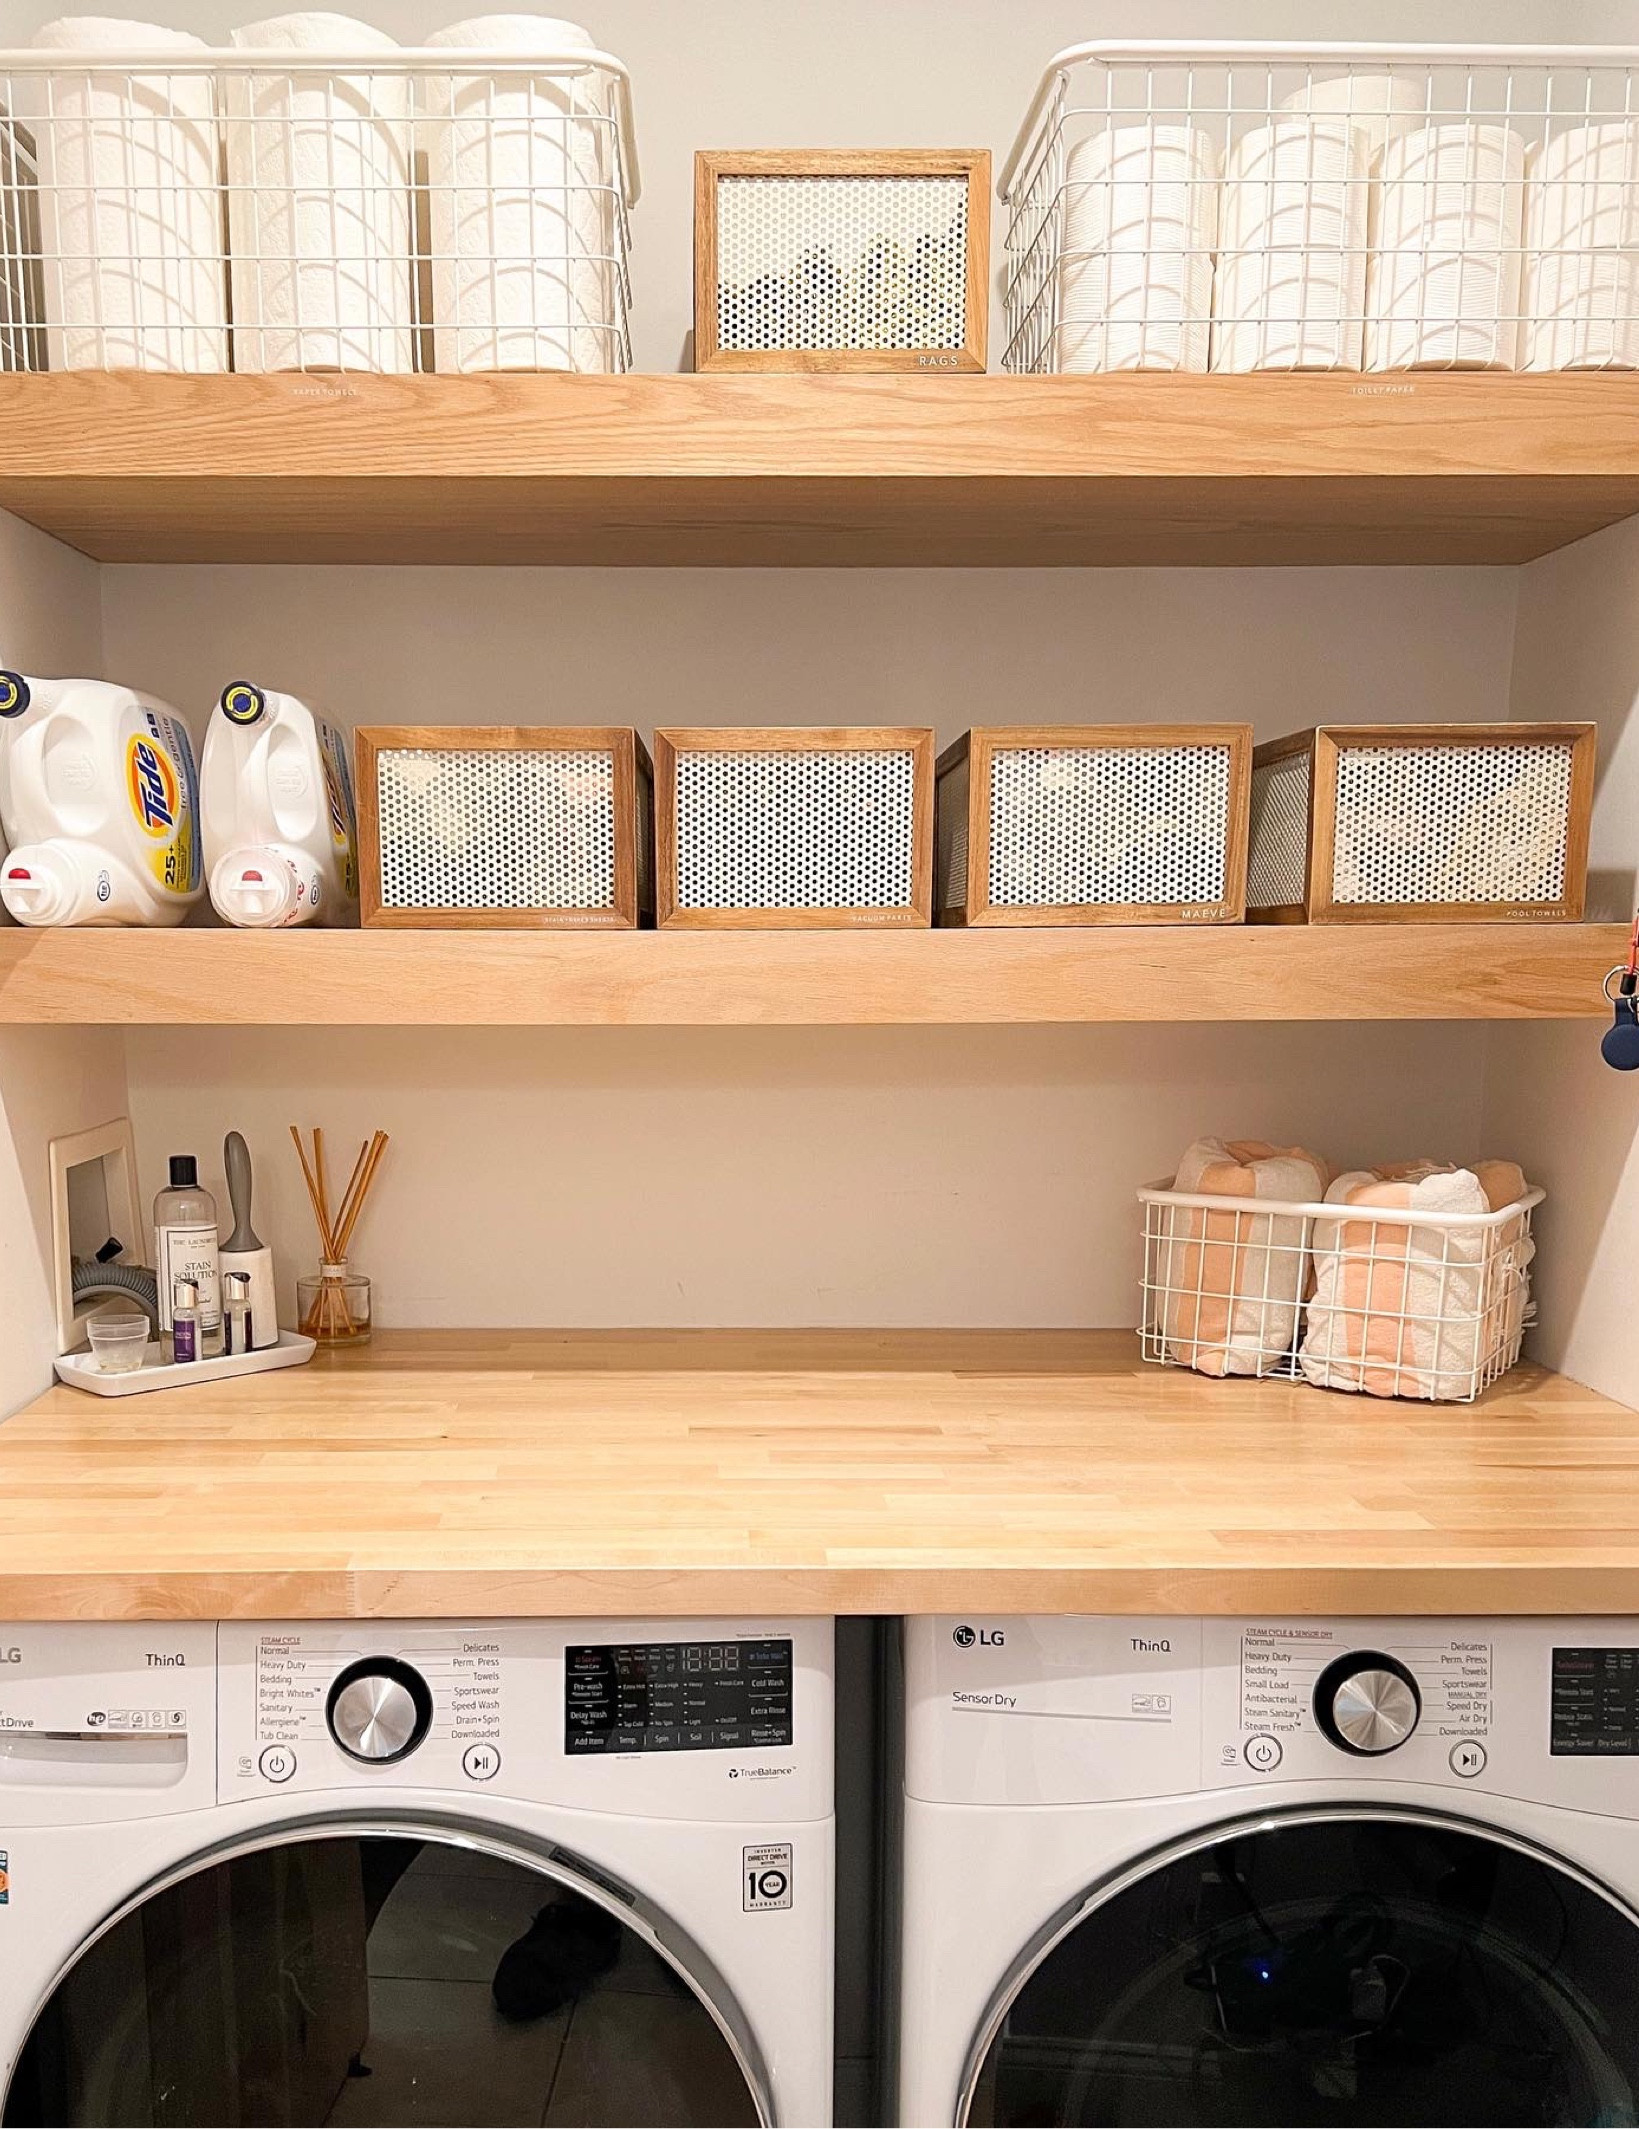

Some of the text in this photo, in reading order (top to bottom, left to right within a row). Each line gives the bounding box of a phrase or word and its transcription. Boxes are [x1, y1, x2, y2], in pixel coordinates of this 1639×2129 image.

[919, 355, 958, 366] RAGS
[137, 741, 174, 827] Tide
[165, 844, 176, 885] 25+
[1182, 909, 1226, 918] MAEVE
[185, 1261, 212, 1271] STAIN
[980, 1630, 1005, 1646] LG
[1245, 1638, 1275, 1647] Normal
[463, 1643, 500, 1653] Delicates
[1131, 1638, 1171, 1652] ThinQ
[1451, 1642, 1488, 1651] Delicates
[260, 1646, 290, 1655] Normal
[145, 1654, 186, 1667] ThinQ
[1245, 1652, 1292, 1662] Heavy Duty
[1466, 1655, 1488, 1664] Press
[260, 1660, 307, 1671] Heavy Duty
[452, 1658, 500, 1667] Perm. Press
[473, 1671, 500, 1680] Towels
[1245, 1666, 1278, 1677] Bedding
[1461, 1667, 1488, 1675] Towels
[260, 1674, 292, 1685] Bedding
[1245, 1680, 1290, 1689] Small Load
[1442, 1680, 1488, 1689] Sportswear
[260, 1689, 285, 1700] Bright
[454, 1686, 500, 1697] Sportswear
[1245, 1694, 1297, 1704] Antibacterial
[260, 1703, 293, 1713] Sanitary
[451, 1700, 500, 1711] Speed Wash
[1446, 1701, 1487, 1711] Speed Dry
[570, 1711, 589, 1720] Delay
[1245, 1708, 1268, 1717] Steam
[0, 1717, 34, 1728] tDrive
[1473, 1714, 1487, 1724] Dry
[1245, 1722, 1270, 1731] Steam
[1439, 1727, 1488, 1736] Downloaded
[260, 1731, 299, 1740] Tub Clean
[451, 1729, 500, 1739] Downloaded
[654, 1734, 669, 1743] Spin
[740, 1768, 792, 1777] TrueBalance
[748, 1870, 788, 1900] 10
